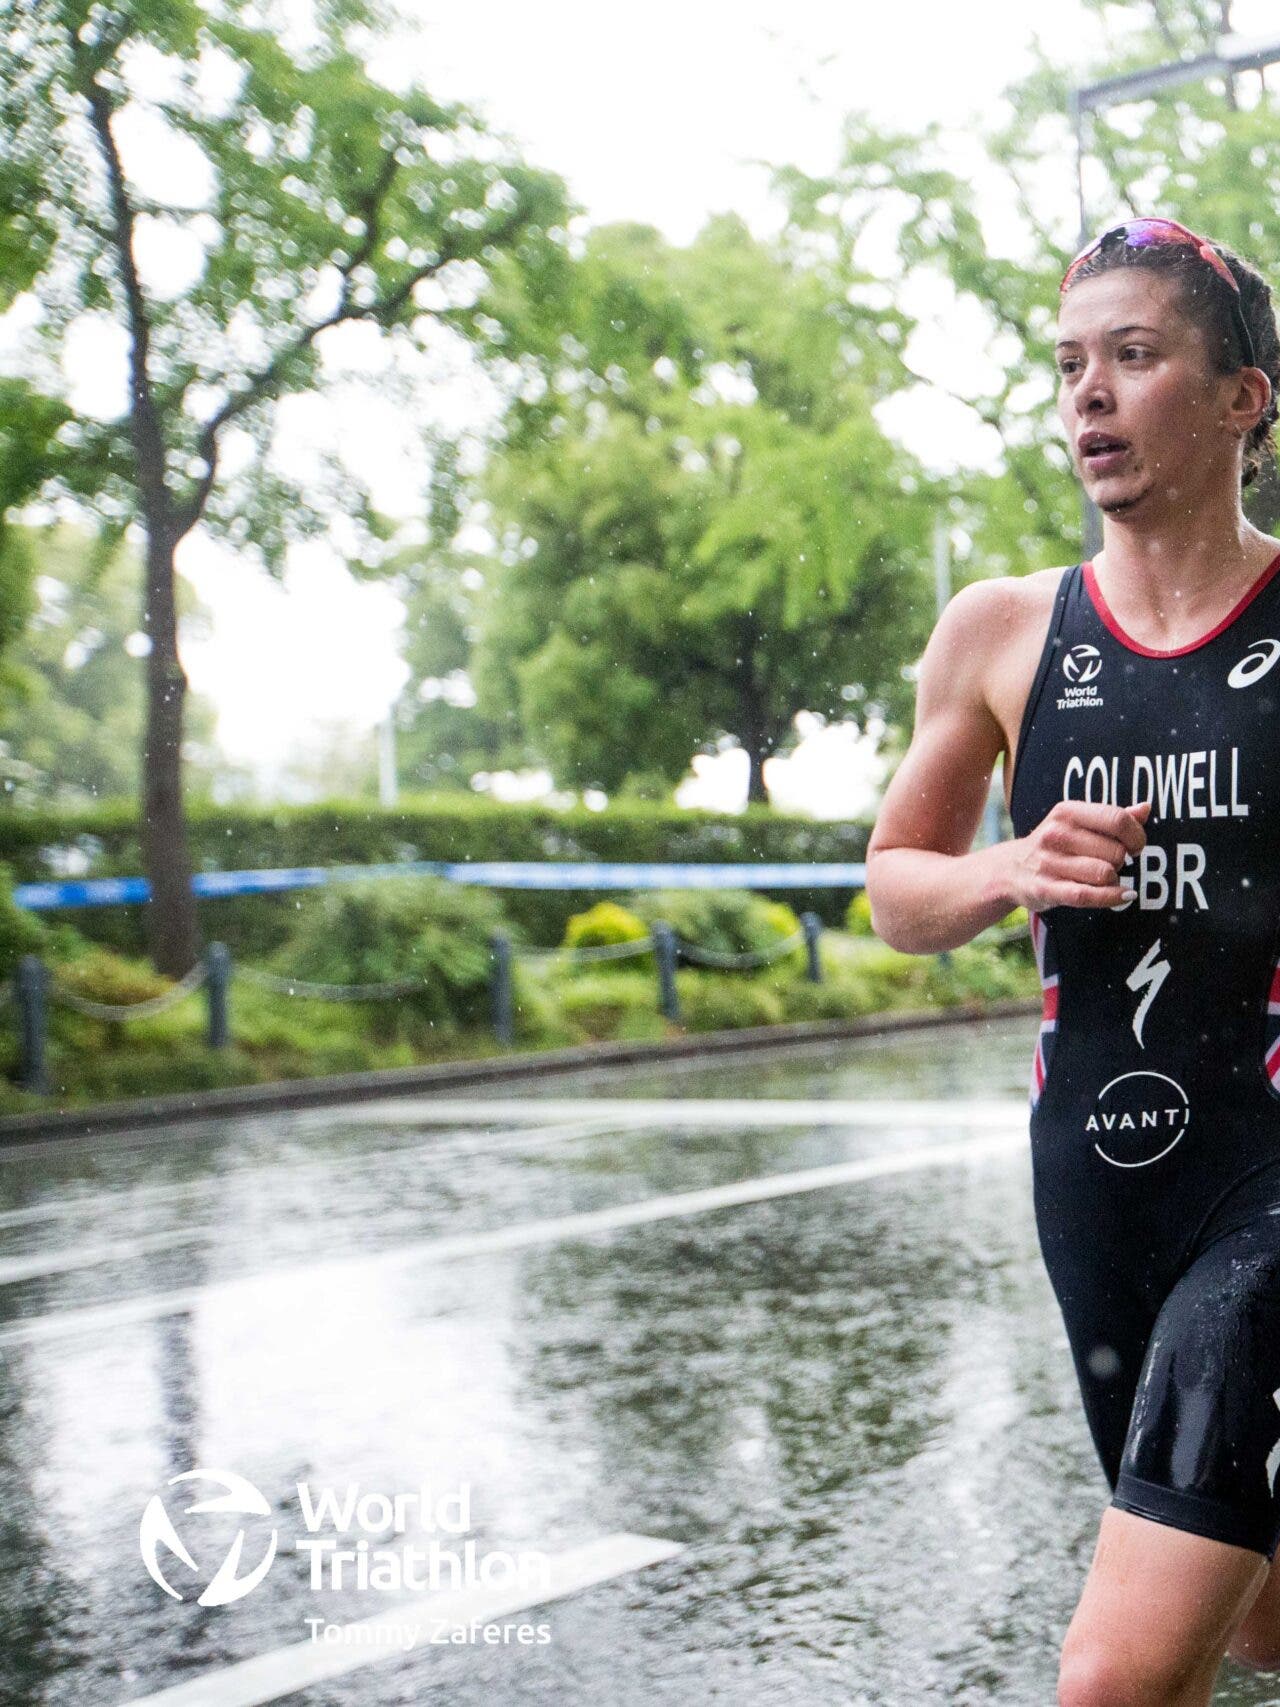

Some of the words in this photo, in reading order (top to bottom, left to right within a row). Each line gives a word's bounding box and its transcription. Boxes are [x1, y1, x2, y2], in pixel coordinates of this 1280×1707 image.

[1064, 685, 1098, 698] World
[1056, 696, 1104, 710] Triathlon
[1063, 748, 1249, 820] COLDWELL
